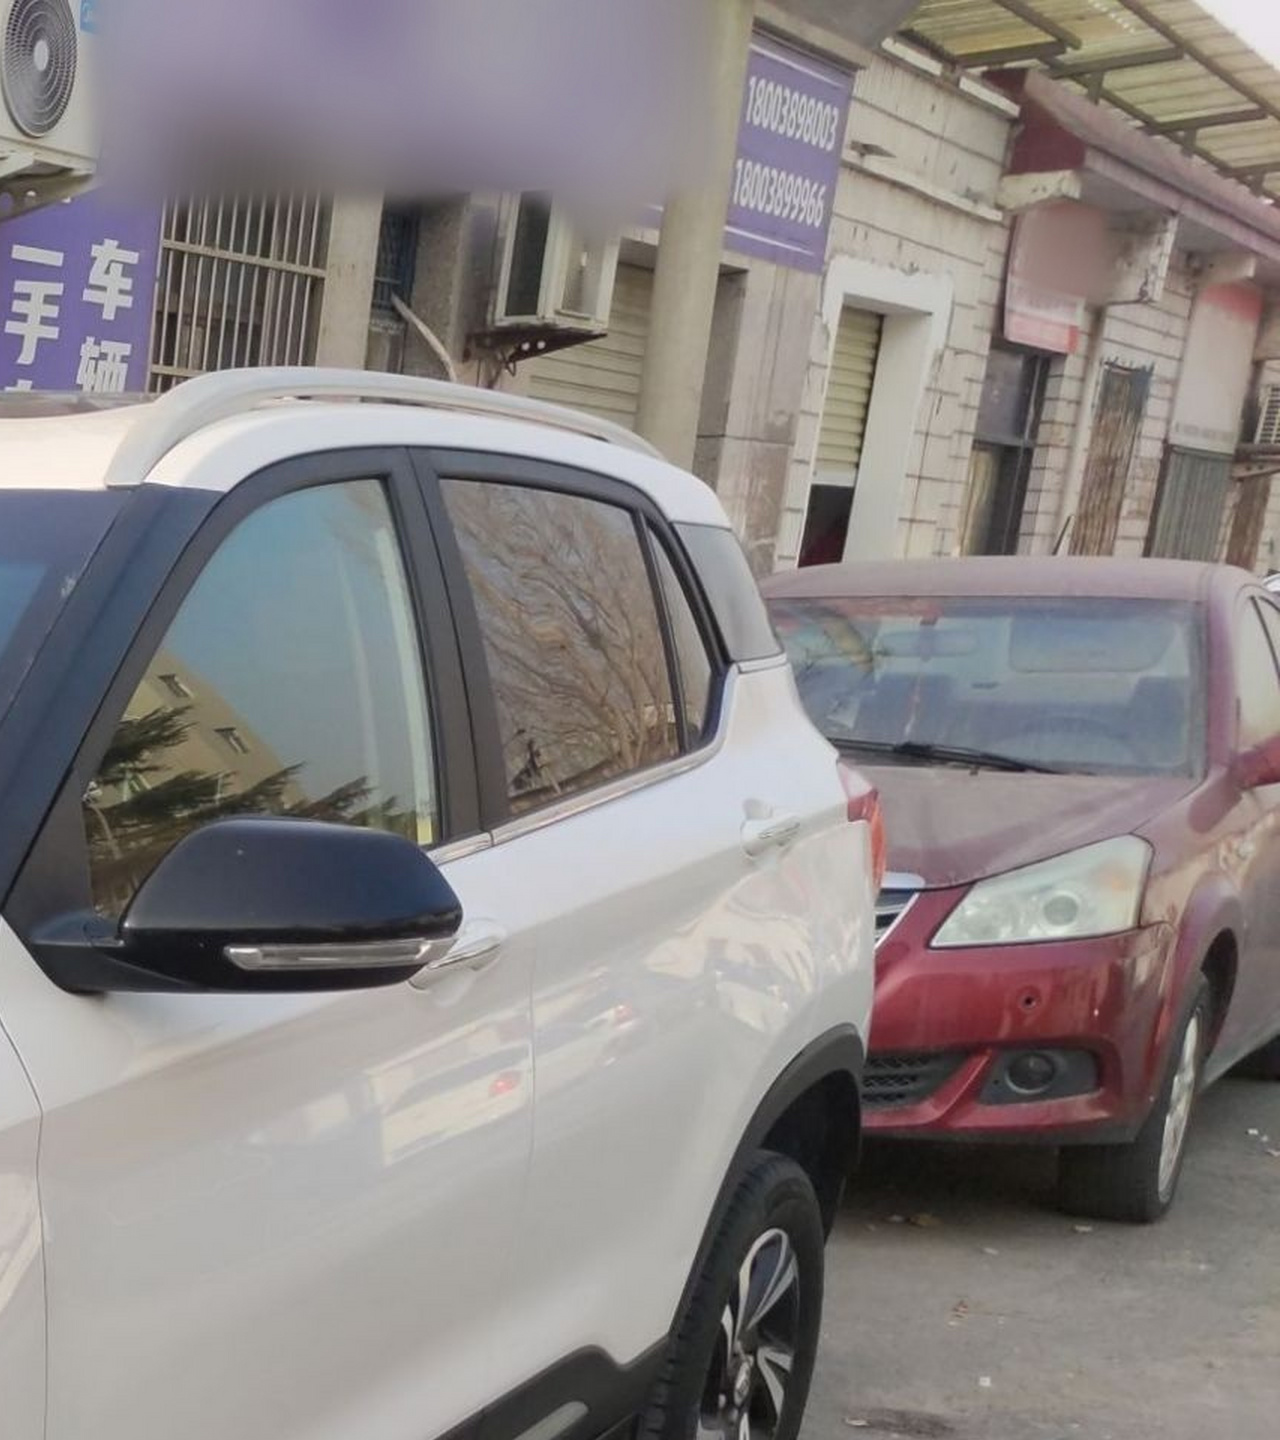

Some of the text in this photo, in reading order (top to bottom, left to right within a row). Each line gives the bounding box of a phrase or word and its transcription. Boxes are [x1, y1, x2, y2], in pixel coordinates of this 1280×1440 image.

[746, 76, 839, 151] 18003898003
[733, 159, 826, 228] 18003899966
[4, 244, 65, 393] 一手
